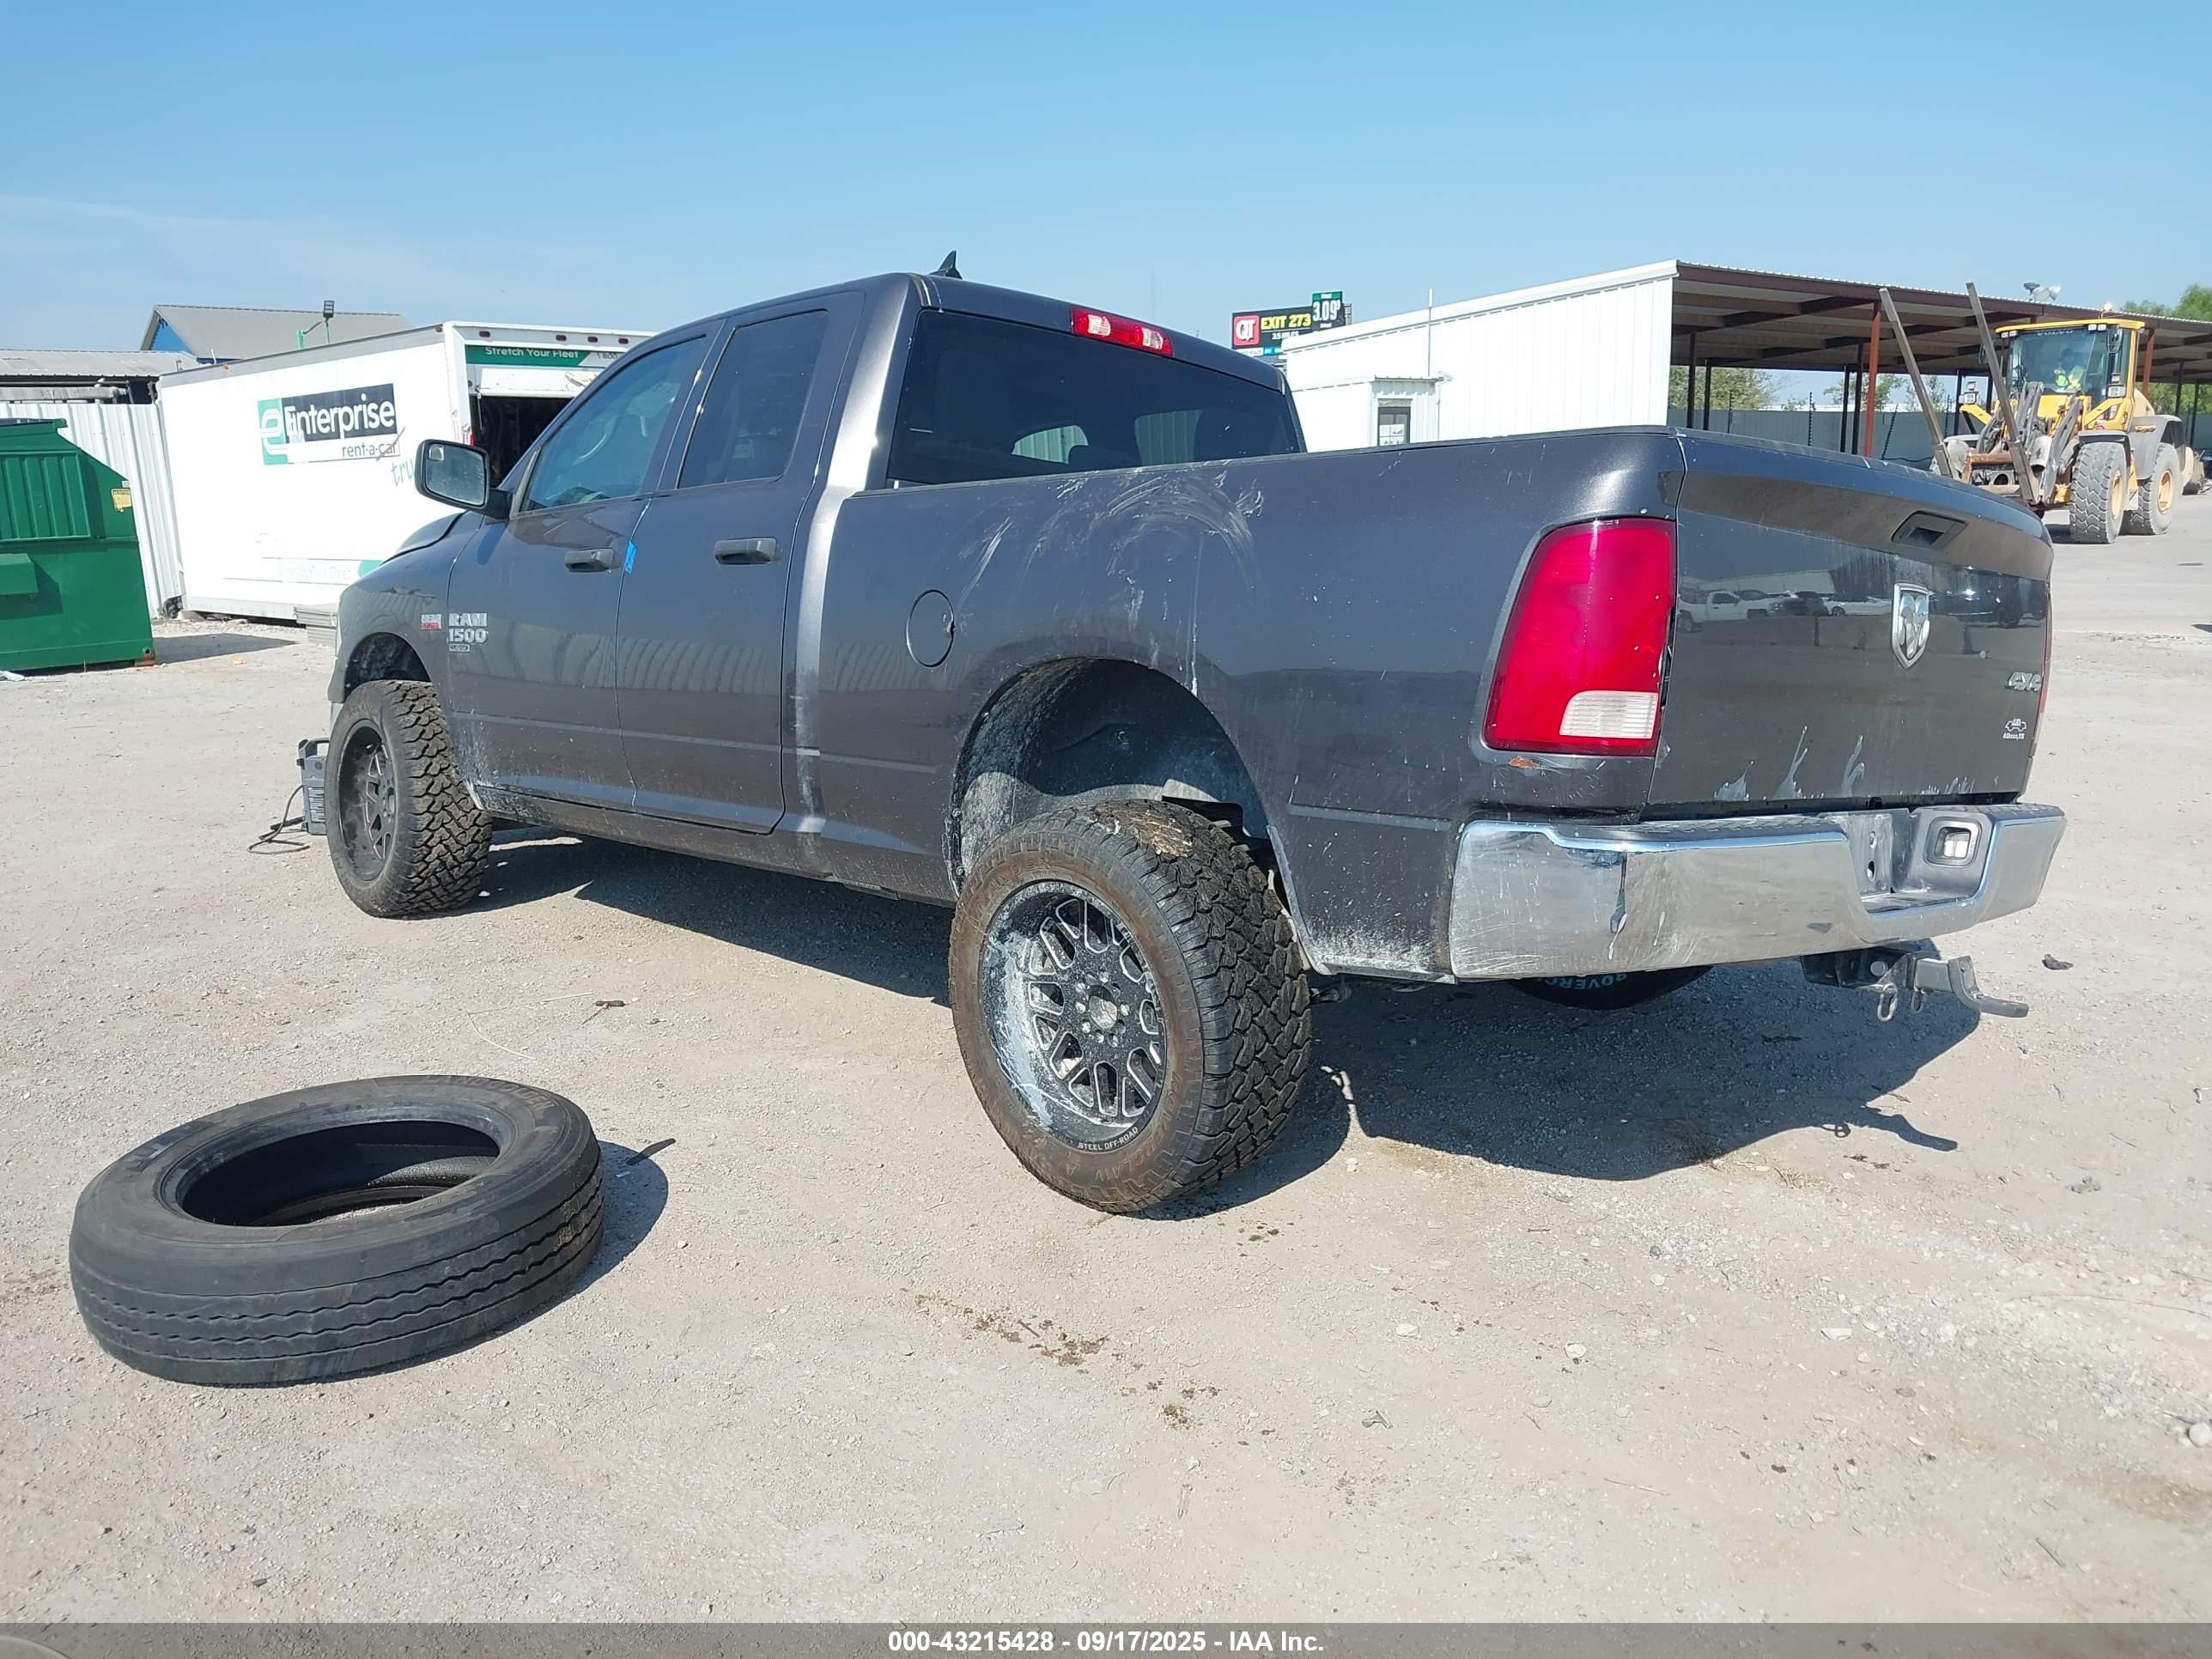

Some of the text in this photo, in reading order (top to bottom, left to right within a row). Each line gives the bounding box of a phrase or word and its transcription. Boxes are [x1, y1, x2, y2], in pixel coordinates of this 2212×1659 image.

[1236, 319, 1255, 341] QT
[1261, 313, 1311, 330] EXIT 273
[485, 346, 524, 356] Stretch
[526, 349, 550, 357] Your
[284, 393, 395, 440] Enterprise
[391, 459, 415, 486] tru
[448, 612, 488, 627] RAM
[448, 628, 489, 643] 1500
[1543, 973, 1628, 989] ROVERC
[1078, 1126, 1139, 1152] STEEL OFF-ROAD
